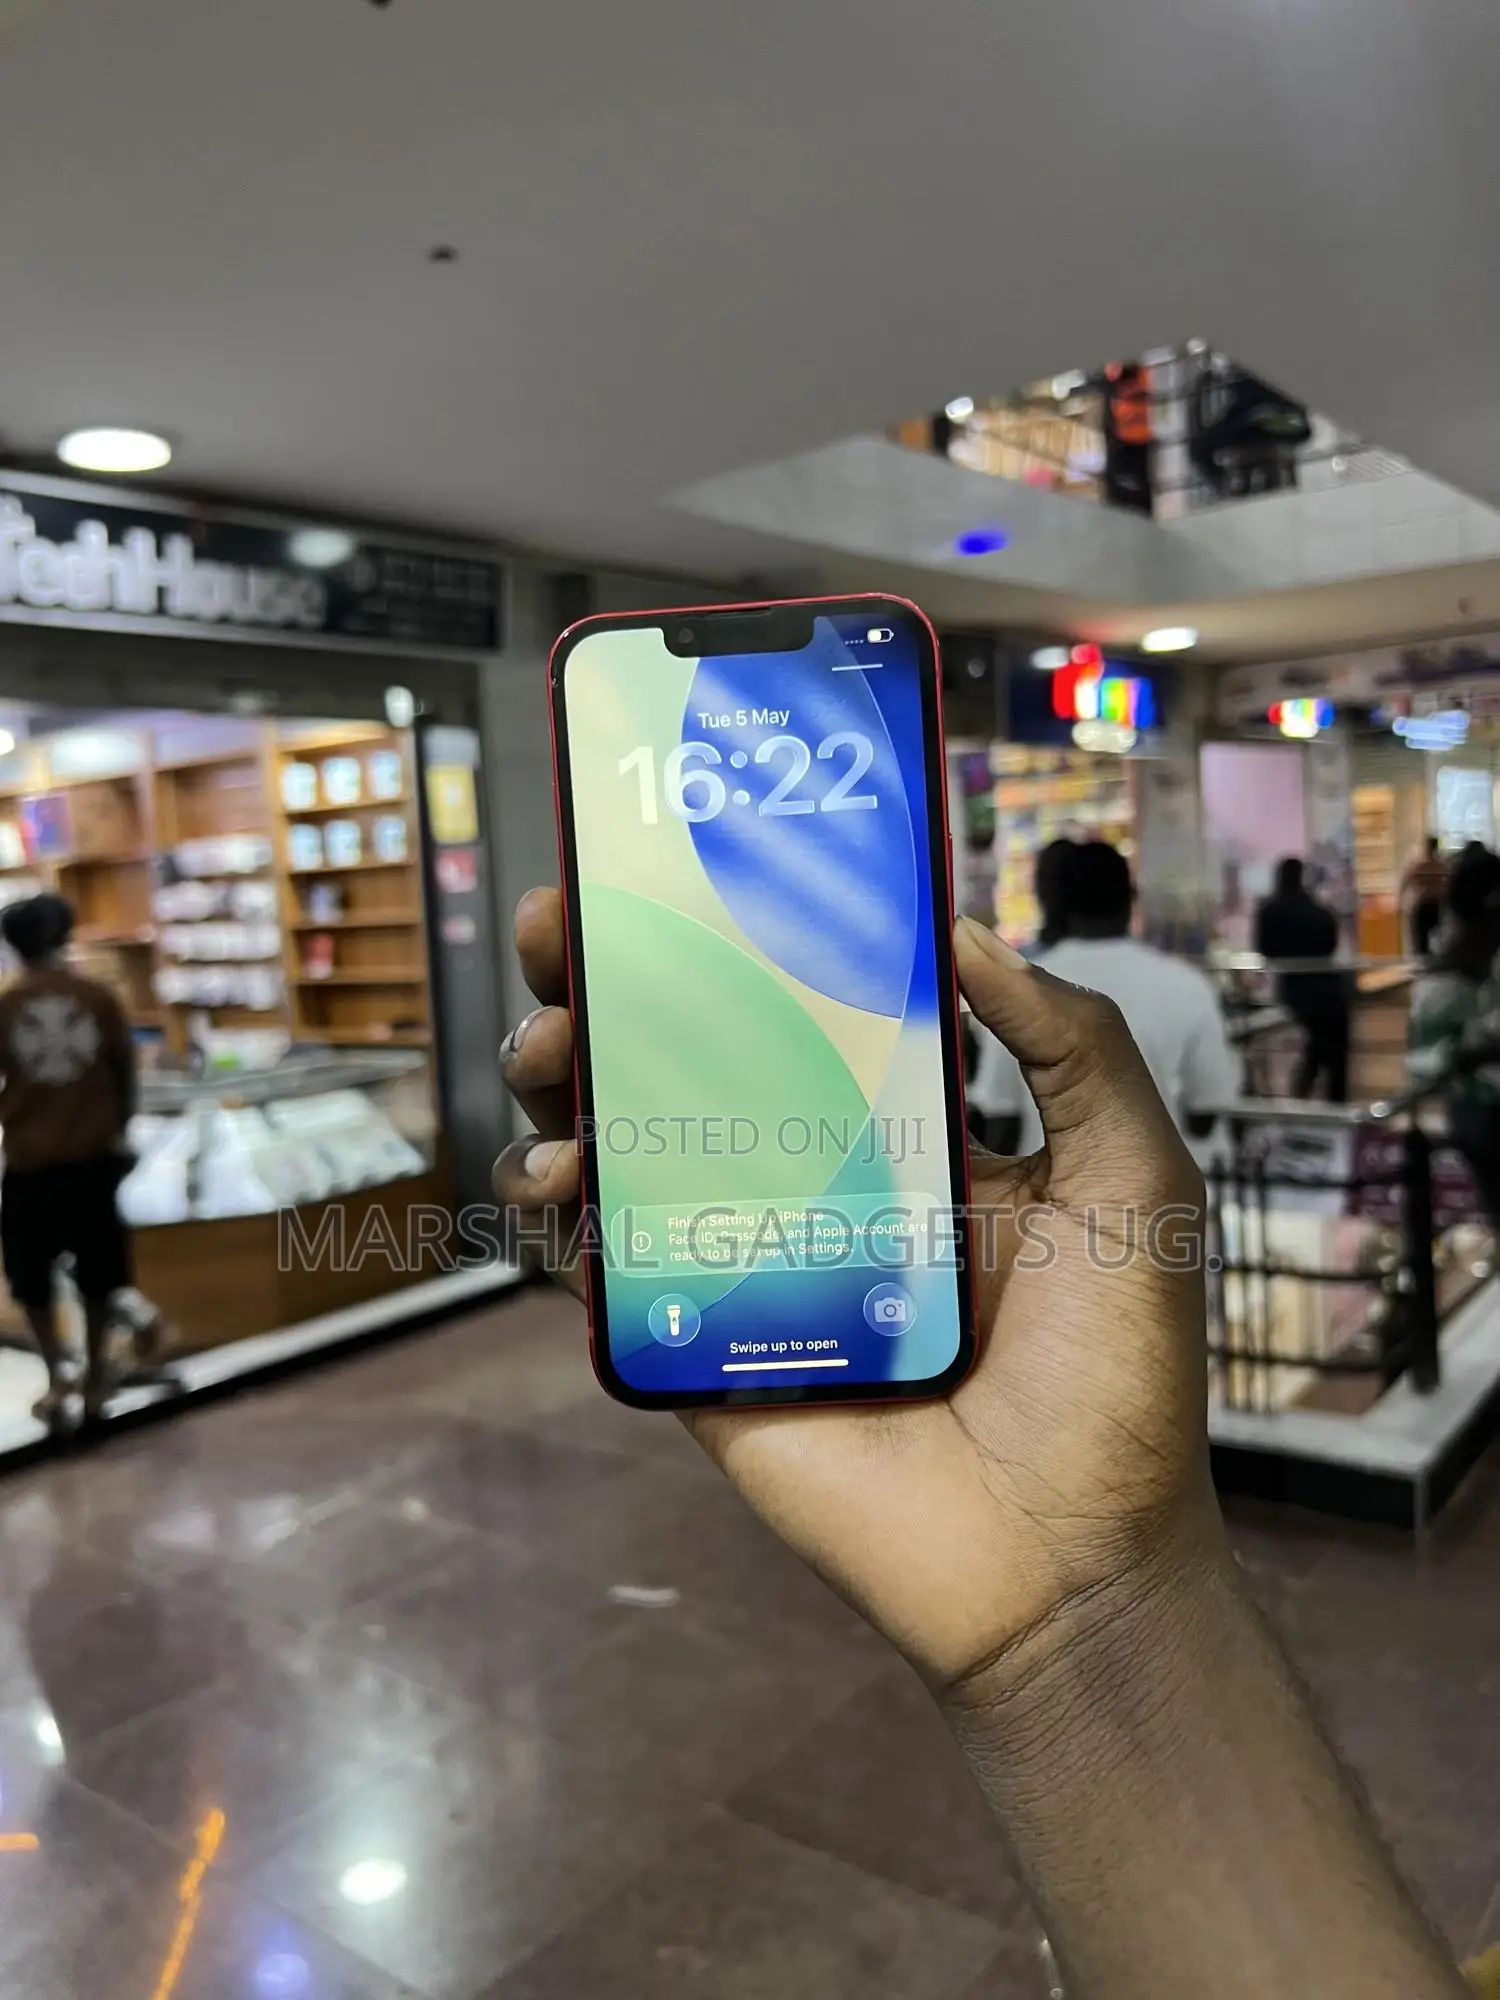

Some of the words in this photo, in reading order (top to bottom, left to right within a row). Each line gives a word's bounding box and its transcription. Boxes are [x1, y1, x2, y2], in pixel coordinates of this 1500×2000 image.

[698, 712, 731, 729] Tue
[736, 710, 748, 725] 5
[752, 708, 790, 727] May
[618, 731, 878, 825] 16:22
[668, 1215, 705, 1229] Finish
[708, 1213, 755, 1227] Setting
[758, 1212, 777, 1225] Up
[780, 1210, 824, 1223] iPhone
[669, 1233, 696, 1245] Face
[788, 1227, 810, 1239] and
[814, 1225, 849, 1239] Apple
[853, 1222, 904, 1236] Account
[908, 1224, 928, 1233] are
[670, 1249, 704, 1262] ready
[708, 1249, 720, 1259] to
[723, 1248, 738, 1258] be
[765, 1248, 781, 1259] up
[784, 1244, 795, 1255] in
[799, 1241, 854, 1256] Settings.
[730, 1341, 769, 1354] Swipe
[771, 1342, 788, 1354] up
[790, 1340, 803, 1351] to
[806, 1339, 838, 1353] open
